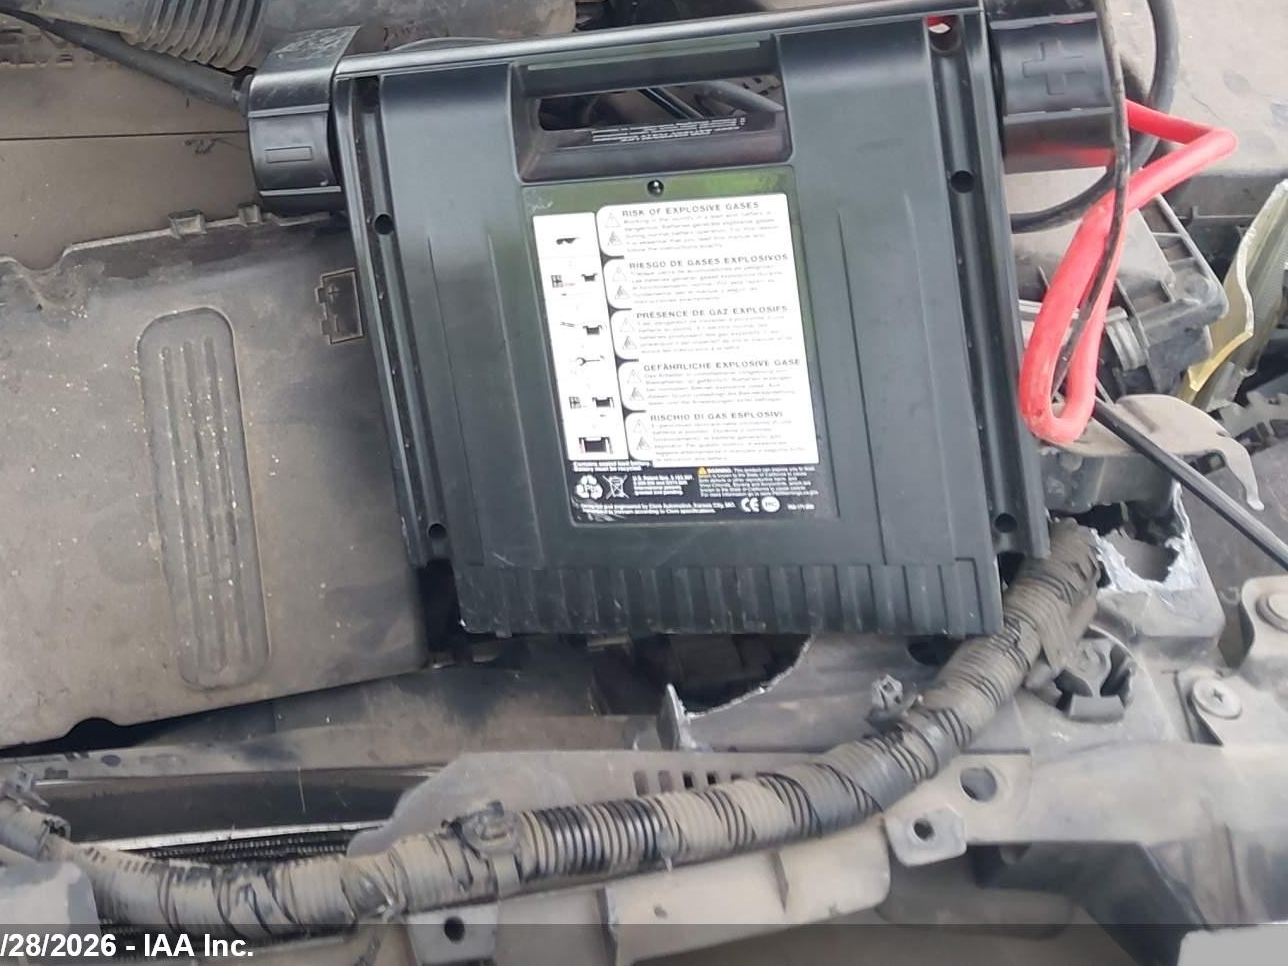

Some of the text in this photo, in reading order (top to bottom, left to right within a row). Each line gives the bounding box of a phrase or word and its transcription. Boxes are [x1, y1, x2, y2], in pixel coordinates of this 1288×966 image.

[665, 203, 721, 215] EXPLOSIVE
[725, 201, 760, 211] GASES
[628, 253, 789, 269] RIESGO DE GASES EXPLOSIVOS
[692, 309, 705, 317] DE
[715, 359, 770, 369] EXPLOSIVE
[774, 358, 801, 367] GASE
[707, 412, 728, 420] GAS
